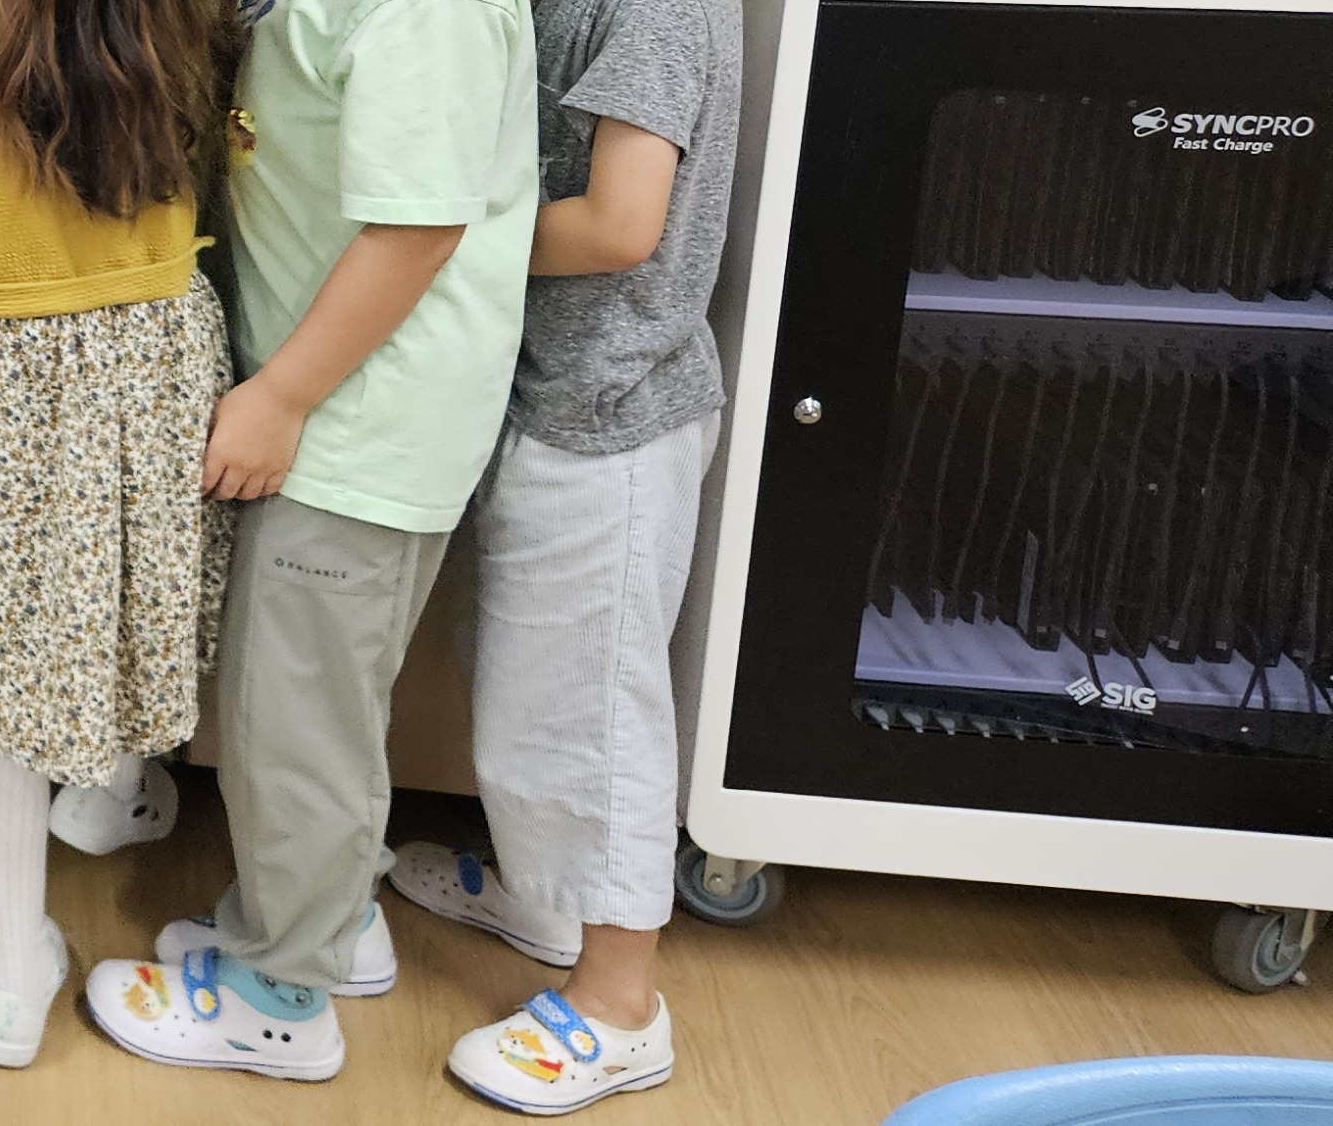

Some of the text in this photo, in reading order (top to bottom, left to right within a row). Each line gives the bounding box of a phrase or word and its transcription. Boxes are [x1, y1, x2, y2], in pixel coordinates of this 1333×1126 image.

[1170, 113, 1315, 137] SYNCPRO
[1173, 136, 1274, 155] Fast Charge
[1101, 682, 1156, 710] SIG
